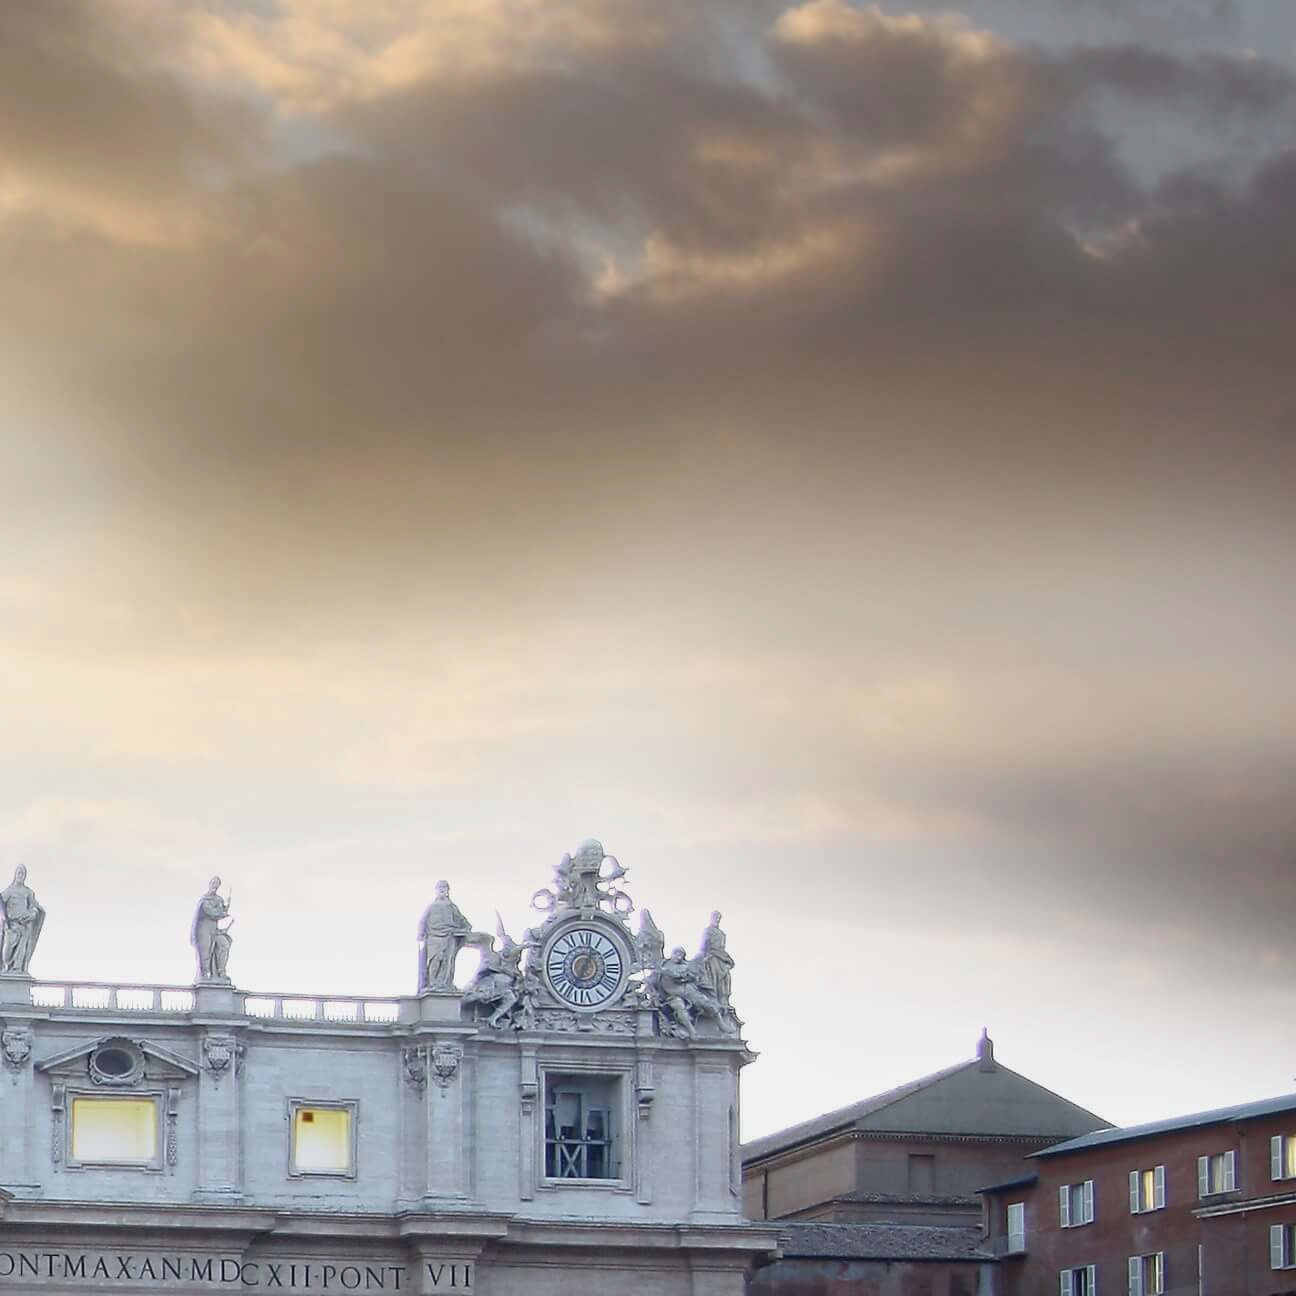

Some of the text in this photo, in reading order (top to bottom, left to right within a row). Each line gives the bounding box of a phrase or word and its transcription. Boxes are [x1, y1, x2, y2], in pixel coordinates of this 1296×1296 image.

[63, 1253, 134, 1280] MAX
[139, 1256, 184, 1282] AN
[191, 1257, 311, 1288] MDCXII
[321, 1264, 407, 1291] PONT
[424, 1263, 472, 1289] VII
